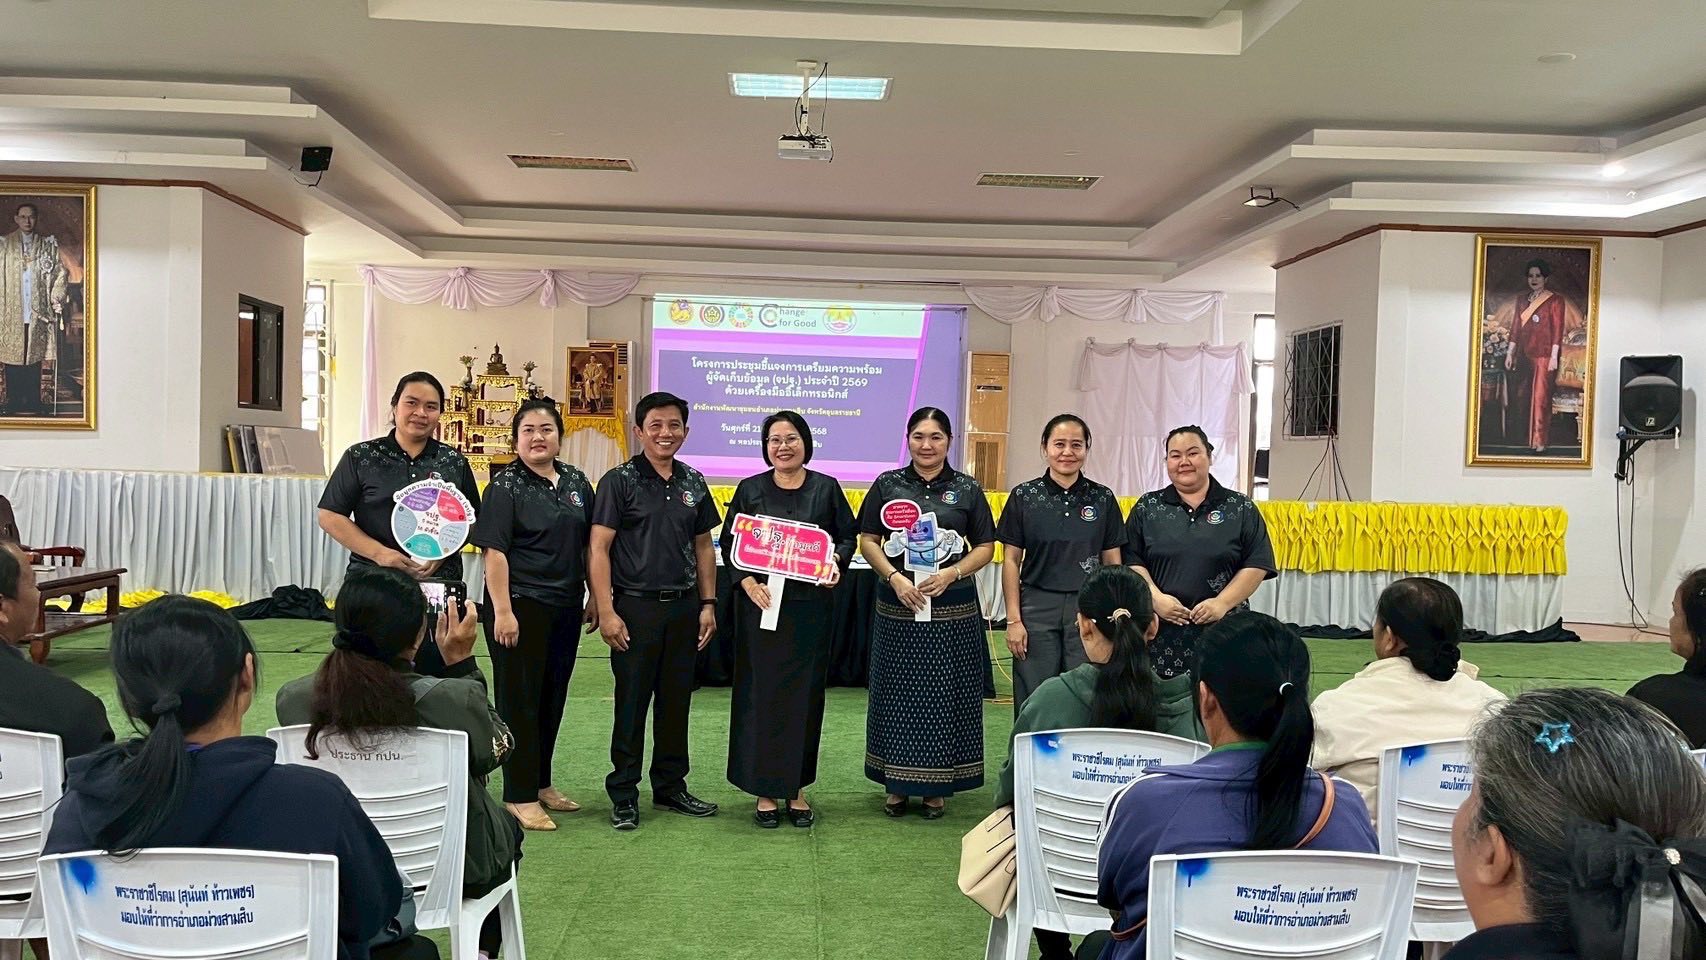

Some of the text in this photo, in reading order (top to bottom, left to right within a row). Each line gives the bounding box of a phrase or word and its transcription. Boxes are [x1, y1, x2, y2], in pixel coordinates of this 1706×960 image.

[780, 318, 816, 328] for Good
[804, 374, 839, 386] ประจำปี
[842, 378, 868, 387] 2569
[811, 427, 827, 435] 568
[330, 749, 370, 761] ประธาน
[120, 904, 254, 928] มอบให้ที่ว่าการอำเภอม่วงสามสิบ
[1233, 904, 1351, 927] มอบให้ที่ว่าการอำเภอม่วงสามสิบ
